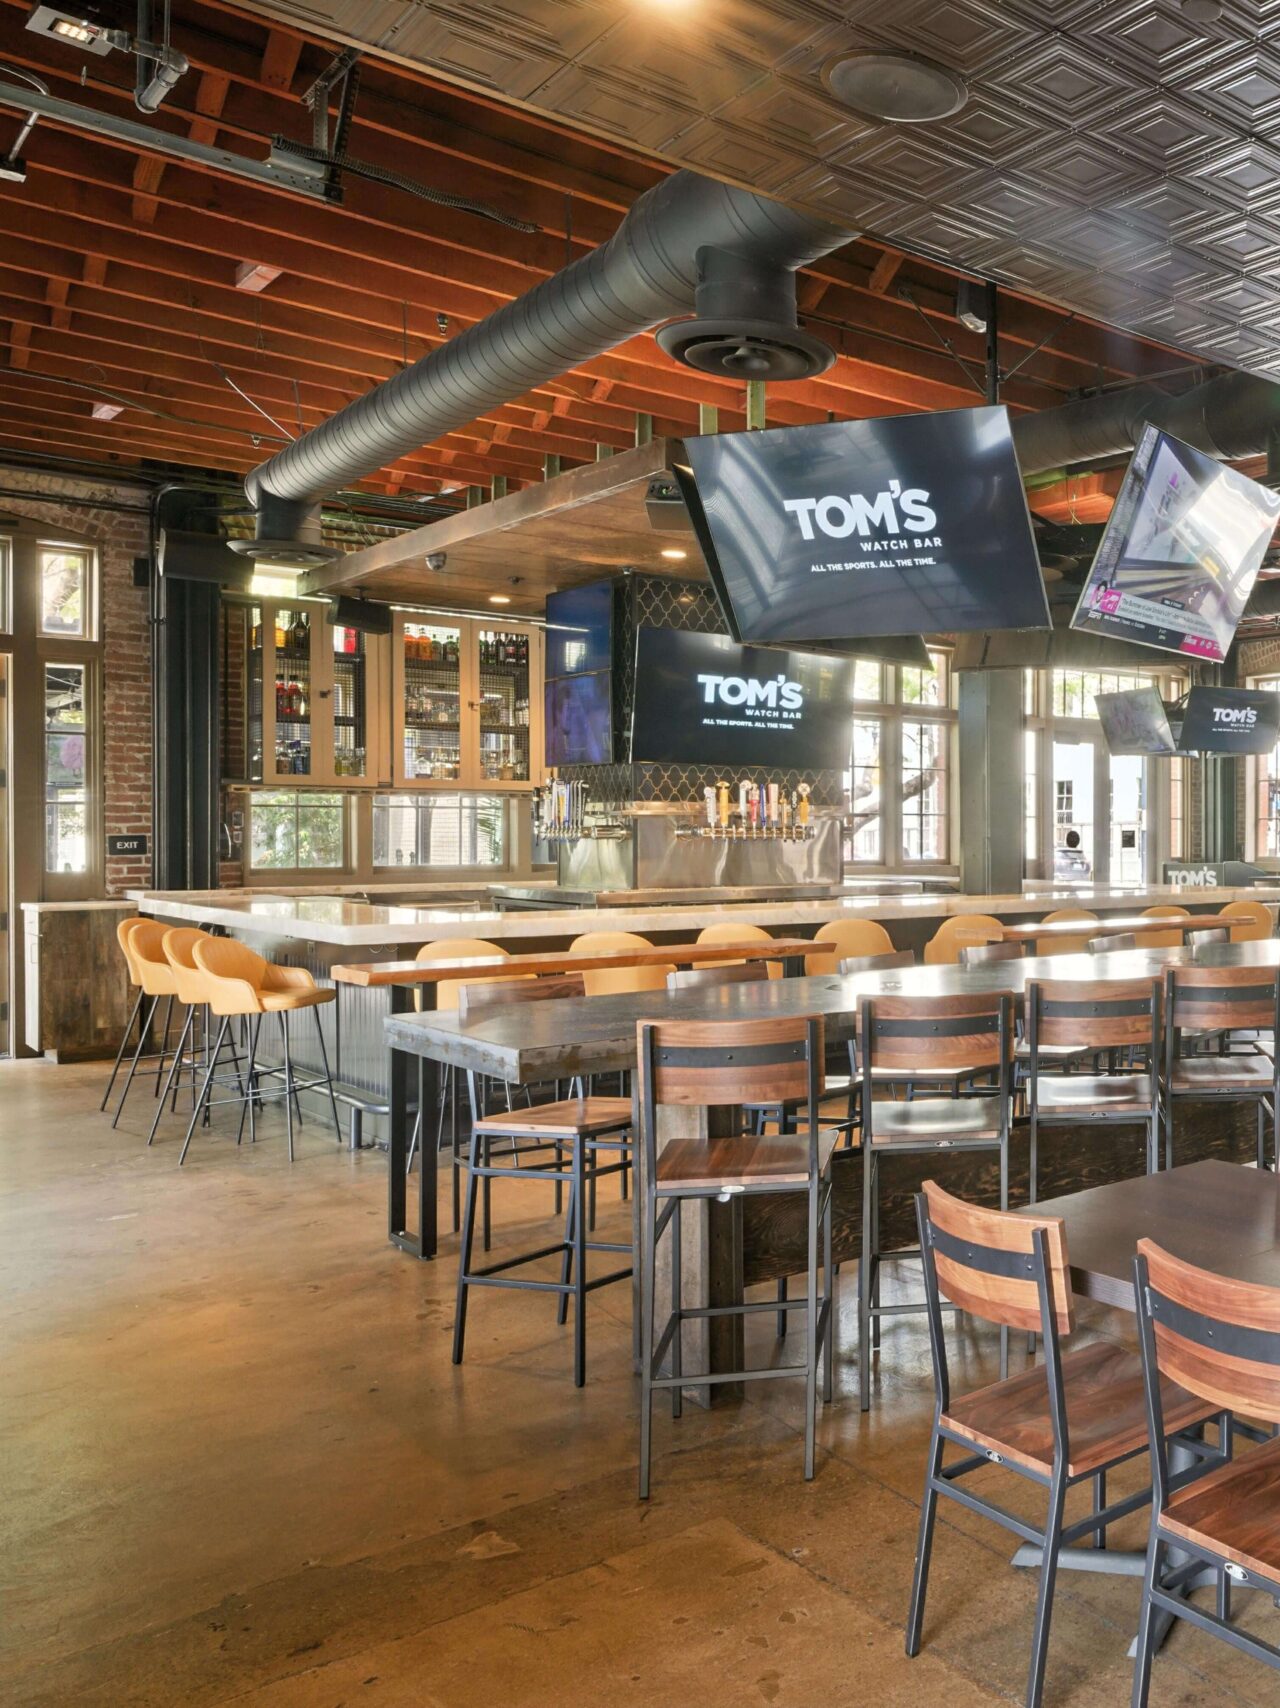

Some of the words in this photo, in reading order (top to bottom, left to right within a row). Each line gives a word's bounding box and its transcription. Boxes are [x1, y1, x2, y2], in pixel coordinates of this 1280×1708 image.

[783, 479, 937, 540] TOM'S
[860, 540, 908, 552] WATCH
[914, 537, 943, 549] BAR
[811, 564, 826, 572] ALL
[827, 563, 843, 571] THE
[844, 561, 878, 570] SPORTS.
[879, 559, 895, 568] ALL
[896, 558, 913, 567] THE
[913, 557, 936, 566] TIME.
[697, 674, 803, 709] TOM'S
[745, 709, 779, 718] WATCH
[782, 711, 802, 719] BAR
[1213, 707, 1257, 723] TOM'S
[116, 841, 138, 849] EXIT
[1168, 866, 1217, 886] TOM'S
